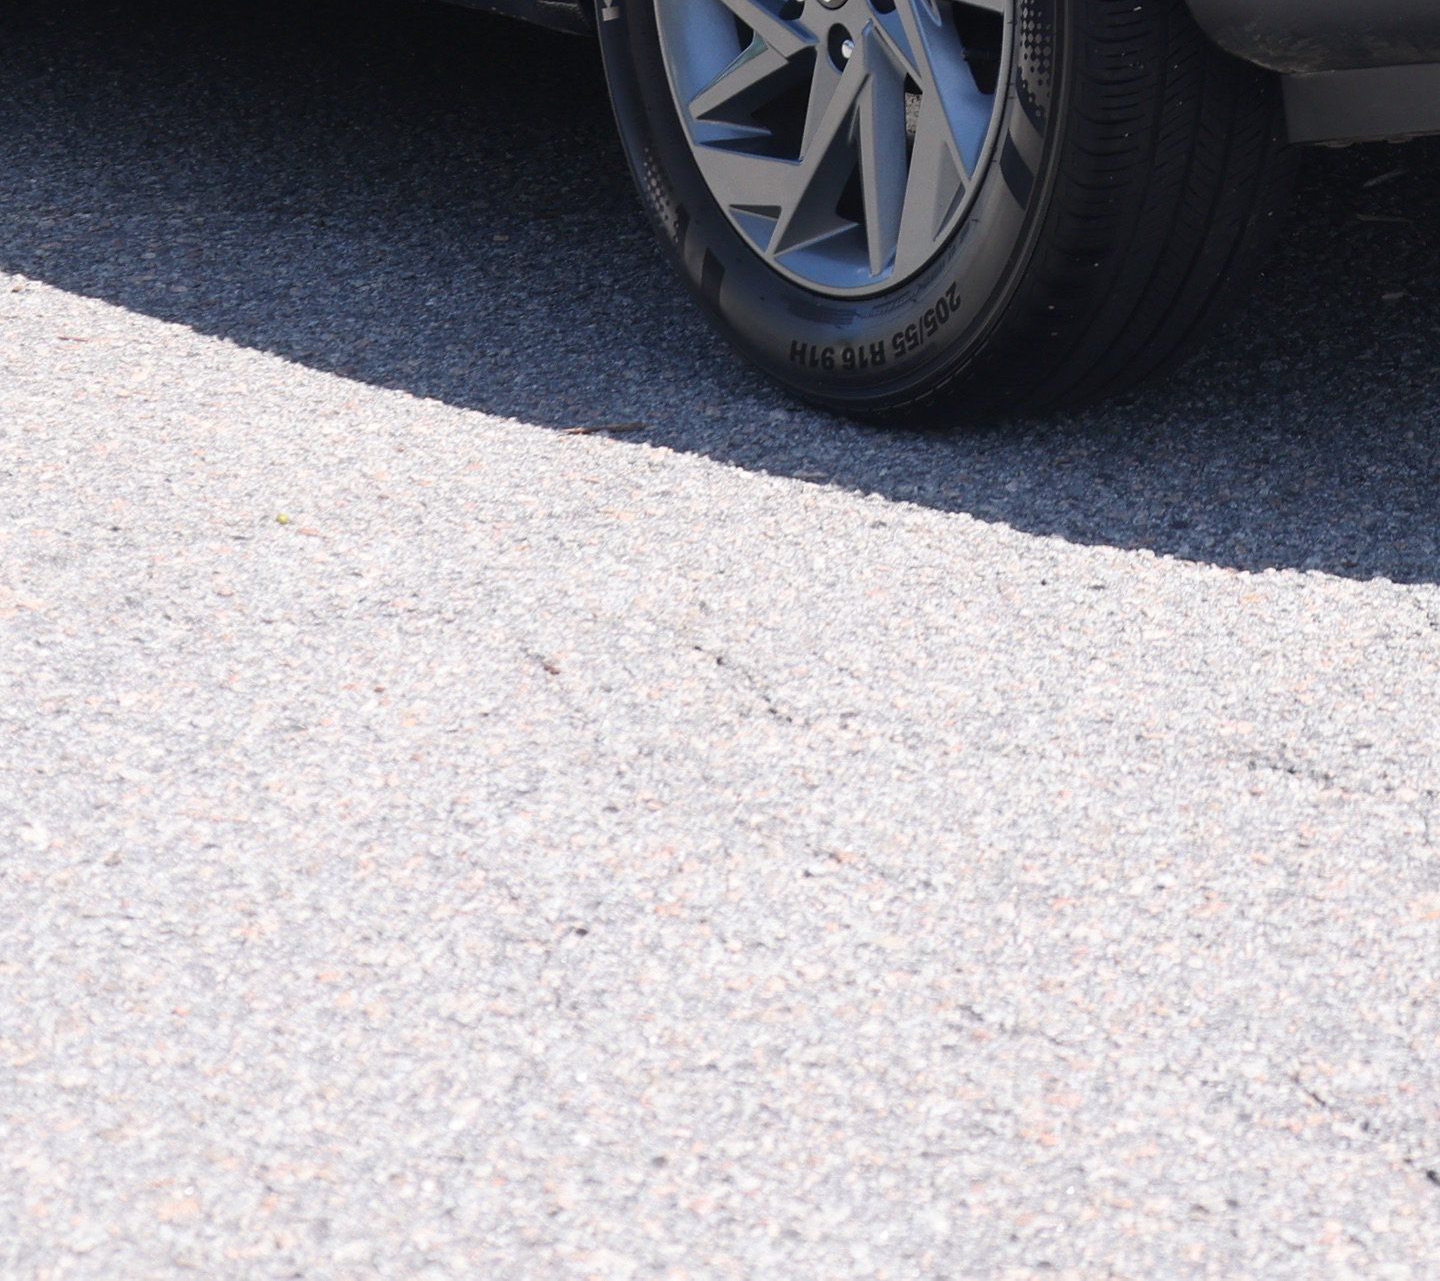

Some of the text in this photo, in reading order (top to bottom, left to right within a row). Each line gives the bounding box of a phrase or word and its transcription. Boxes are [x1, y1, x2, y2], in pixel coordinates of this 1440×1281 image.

[790, 279, 962, 372] 205/55 R16 91H
